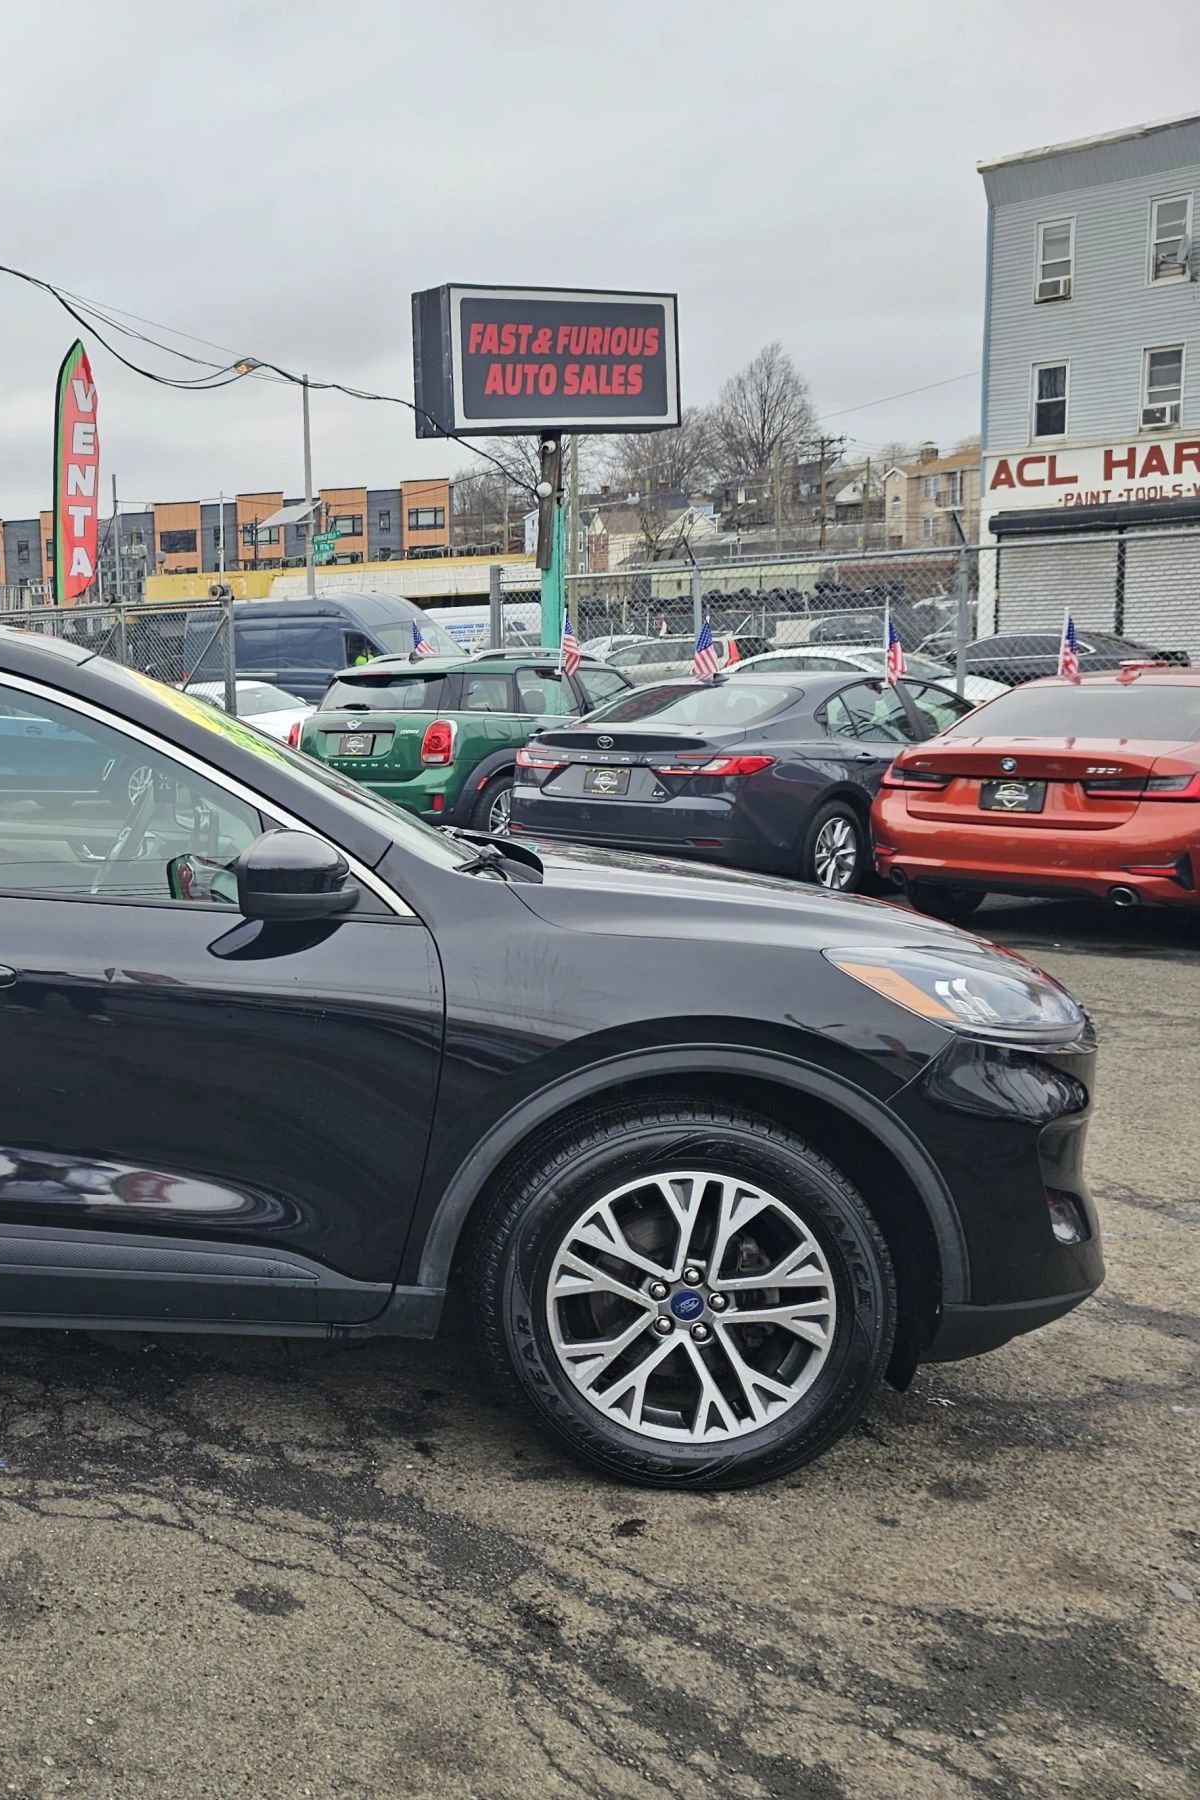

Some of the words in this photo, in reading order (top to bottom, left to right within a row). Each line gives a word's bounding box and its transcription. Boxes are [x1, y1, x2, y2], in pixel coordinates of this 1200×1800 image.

[556, 325, 659, 357] FURIOUS
[484, 363, 557, 396] AUTO
[563, 363, 643, 396] SALES
[67, 378, 97, 578] VENTA
[990, 455, 1078, 490] ACL
